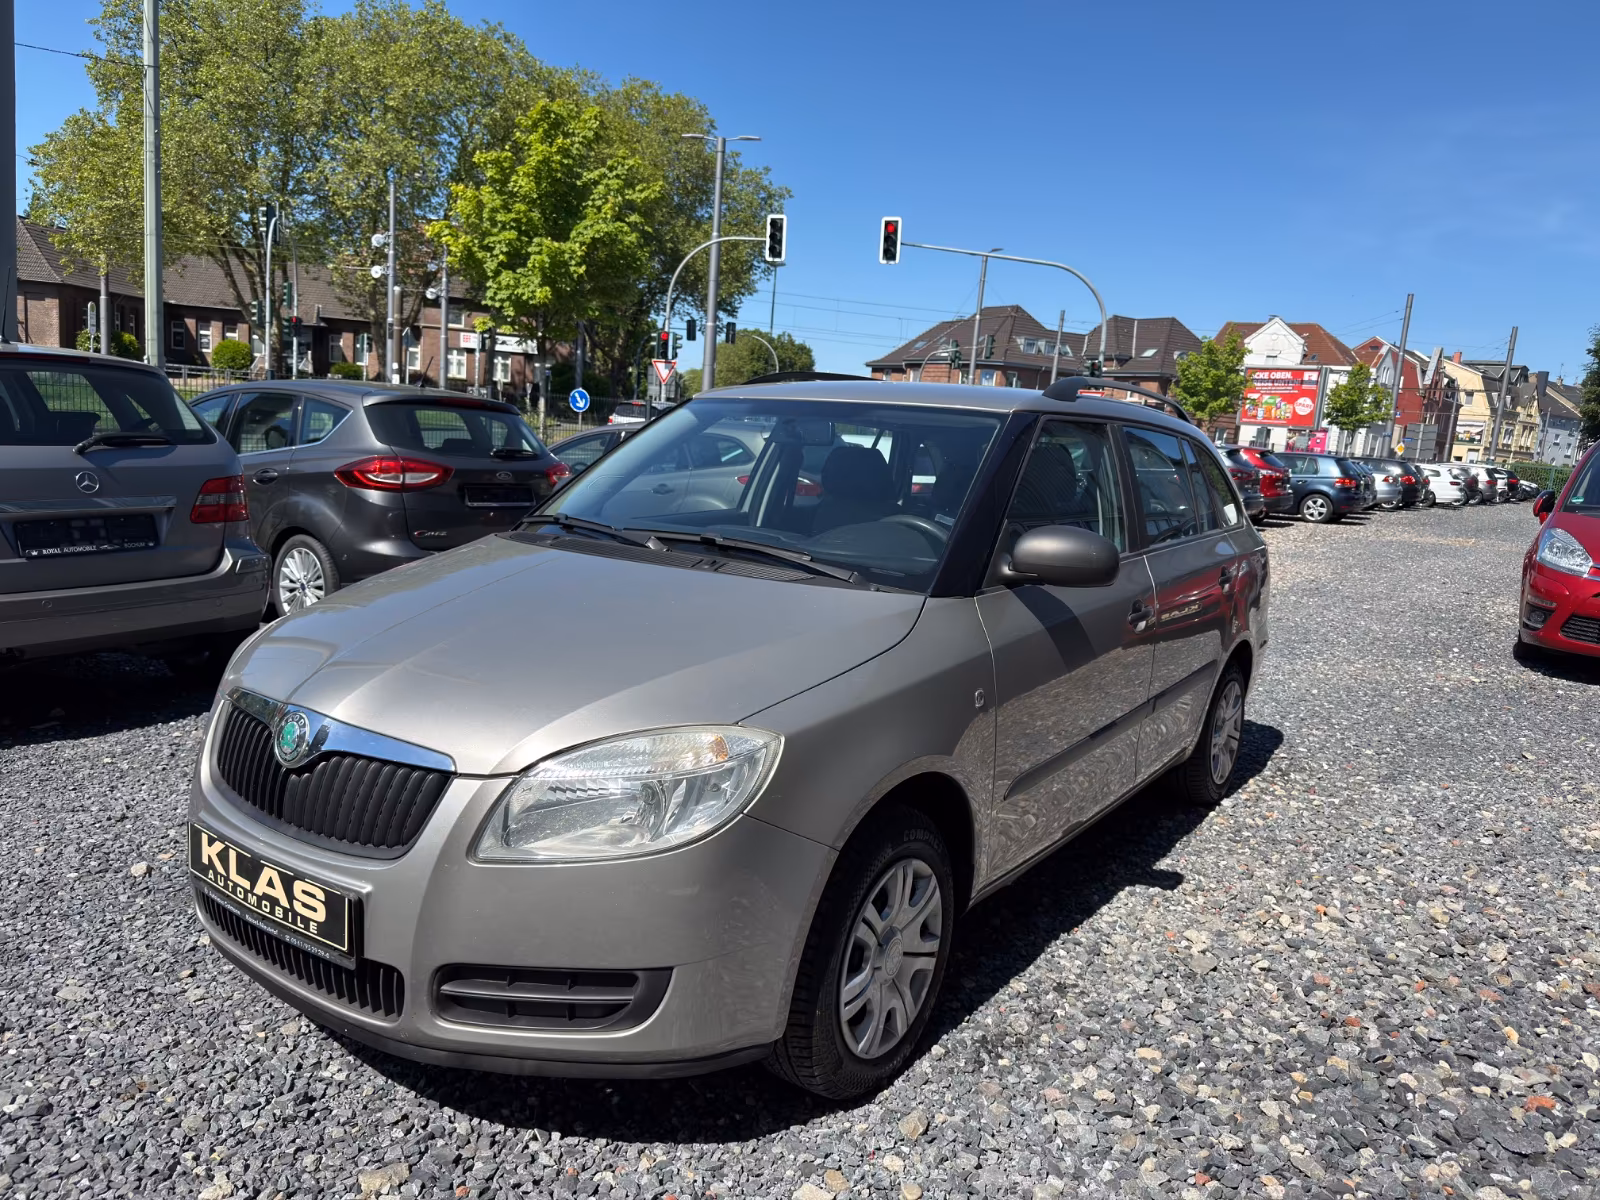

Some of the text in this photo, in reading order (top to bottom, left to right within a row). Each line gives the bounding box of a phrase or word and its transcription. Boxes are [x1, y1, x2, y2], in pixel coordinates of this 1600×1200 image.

[1270, 371, 1293, 380] OBEN.
[42, 547, 62, 555] ROYAL
[63, 545, 97, 553] AUTOMOBILE
[201, 832, 326, 922] KLAS
[208, 869, 318, 934] AUTOMOBILE
